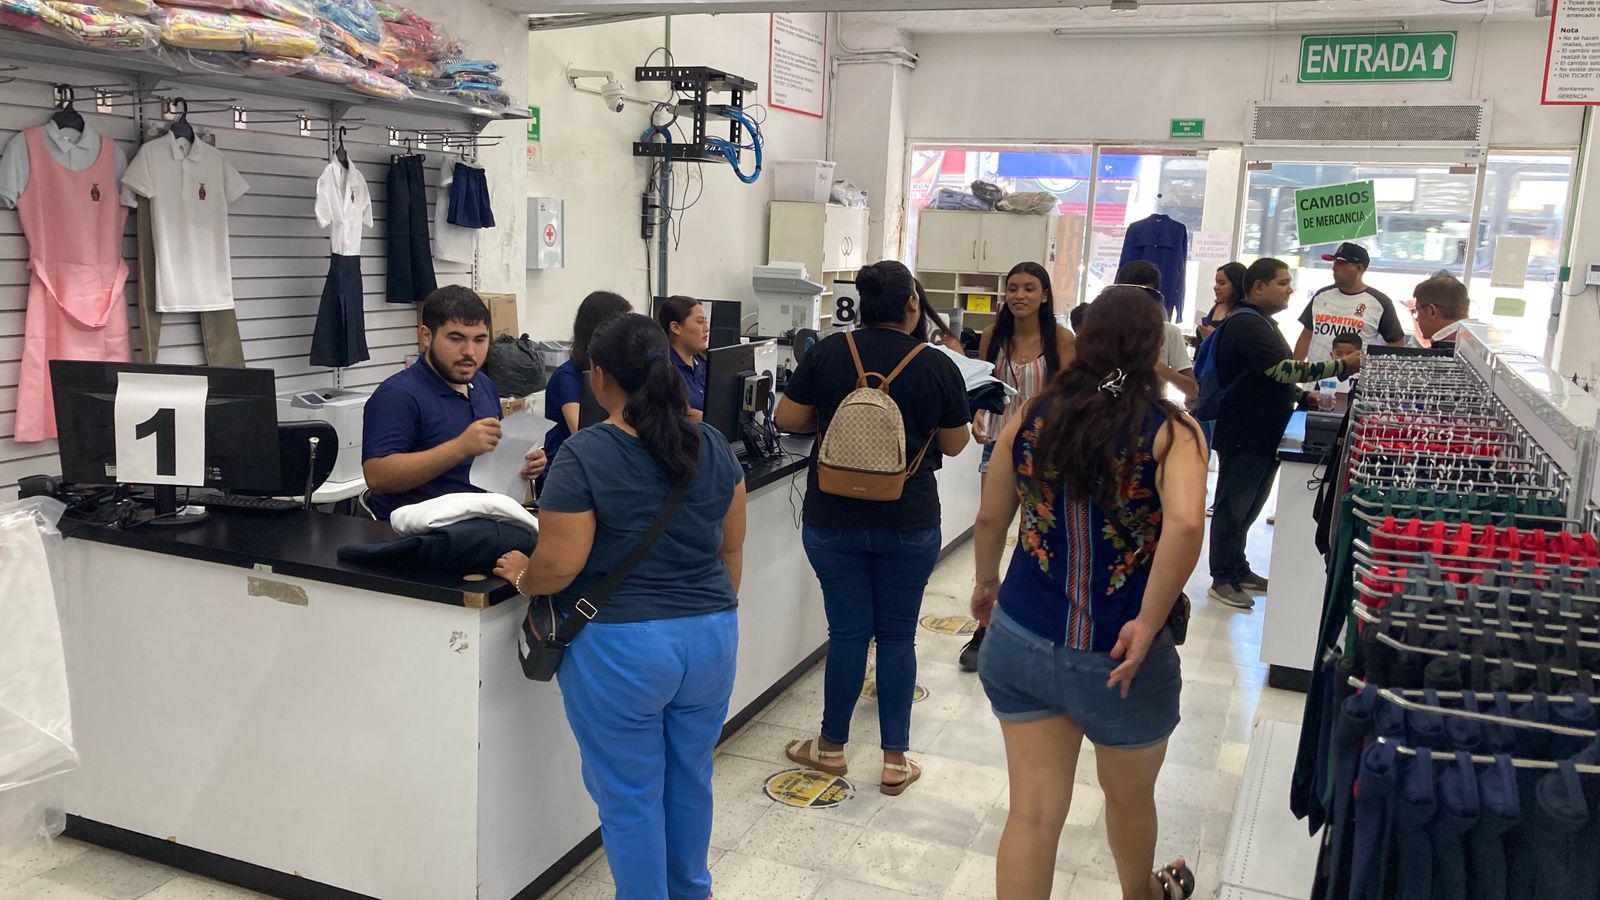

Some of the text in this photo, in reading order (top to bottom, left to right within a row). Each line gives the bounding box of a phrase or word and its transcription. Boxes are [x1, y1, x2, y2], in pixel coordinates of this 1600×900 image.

[1306, 42, 1427, 74] ENTRADA
[1300, 190, 1370, 211] CAMBIOS
[1303, 211, 1366, 229] DE MERCANCIA
[836, 296, 856, 322] 8
[1315, 313, 1365, 329] DEPORTIVO
[135, 408, 176, 476] 1
